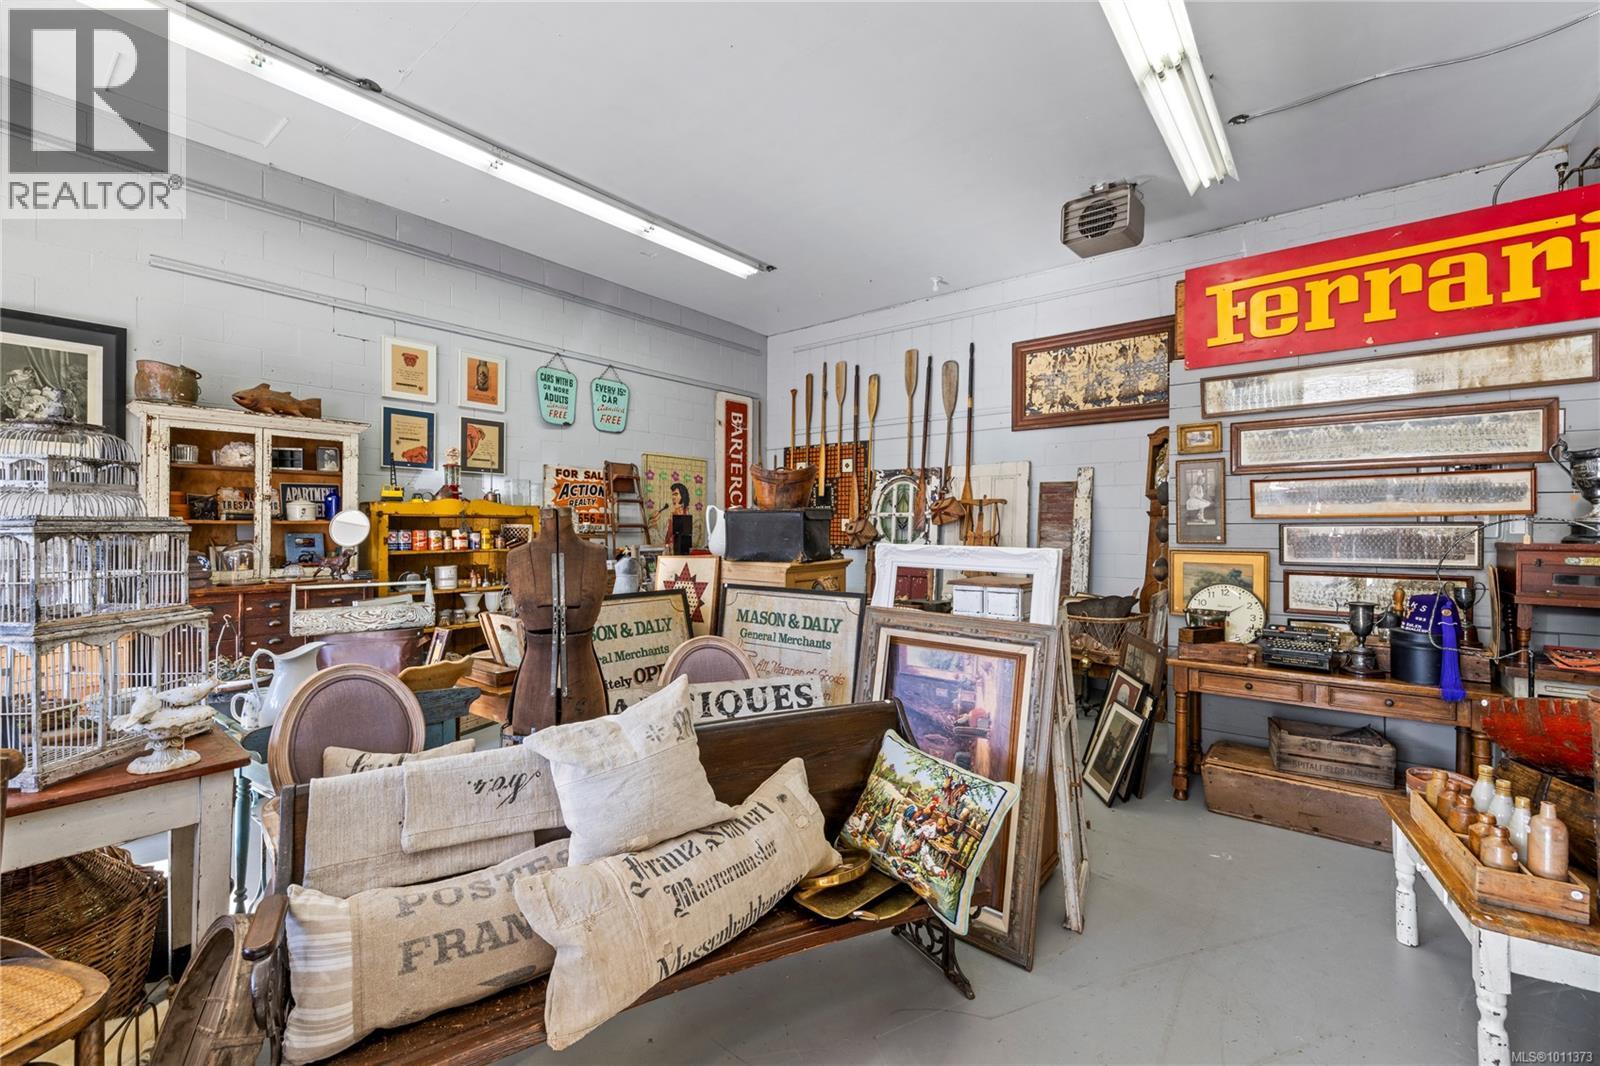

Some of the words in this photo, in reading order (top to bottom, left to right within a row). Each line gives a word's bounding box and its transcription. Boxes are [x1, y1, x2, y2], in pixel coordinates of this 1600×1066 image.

[540, 372, 554, 384] CARS
[555, 376, 568, 387] WITH
[553, 386, 569, 395] MORE
[595, 383, 616, 396] EVERY
[544, 392, 569, 405] ADULTS
[601, 394, 618, 405] CAR
[548, 409, 568, 420] FREE
[600, 414, 622, 426] FREE
[555, 468, 579, 479] FOR
[1221, 589, 1230, 597] 12
[1246, 602, 1253, 610] 2
[736, 608, 787, 628] MASON
[788, 613, 801, 630] &
[801, 615, 843, 634] DALY
[620, 622, 634, 639] &
[634, 617, 673, 636] DALY
[739, 628, 777, 643] General
[778, 632, 832, 650] Merchants
[615, 645, 670, 663] Merchants
[398, 911, 534, 976] FRAN
